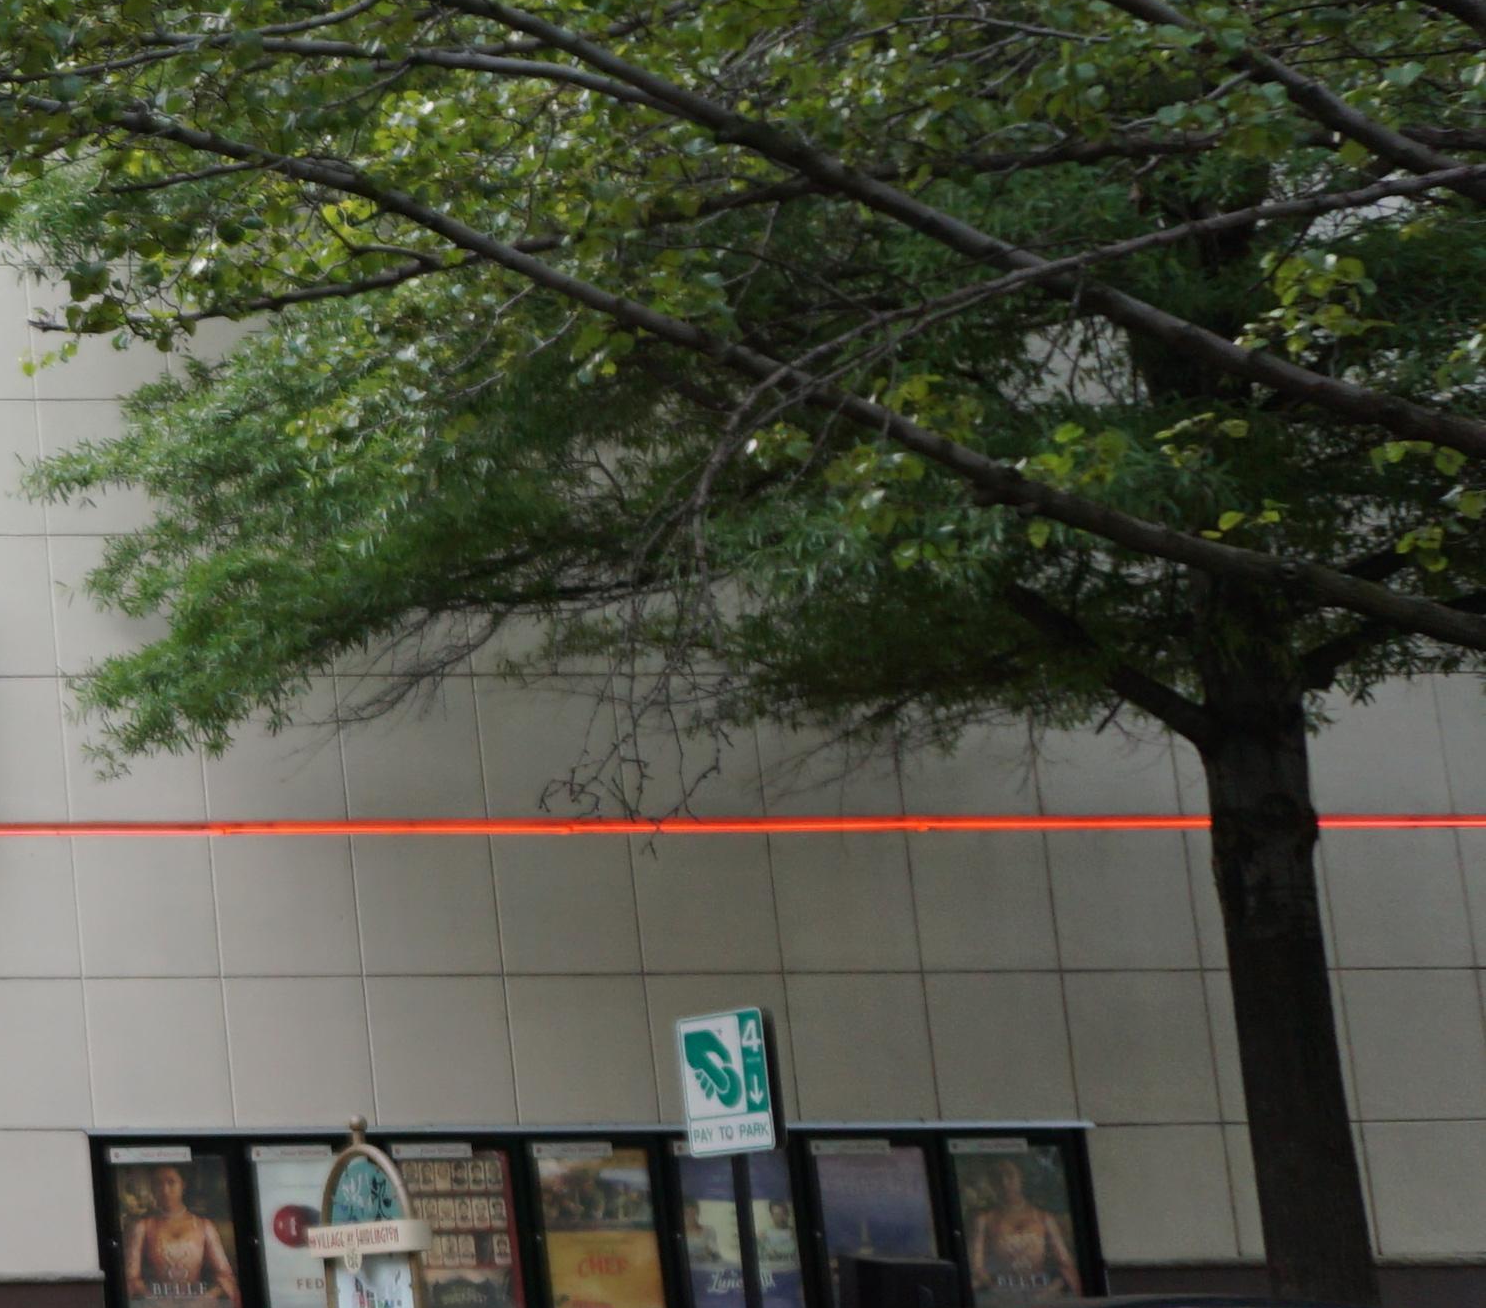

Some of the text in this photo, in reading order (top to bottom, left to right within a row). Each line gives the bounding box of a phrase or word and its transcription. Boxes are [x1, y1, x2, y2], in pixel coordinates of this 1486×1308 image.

[741, 1019, 761, 1052] 4
[693, 1121, 770, 1143] PAY TO PARK
[316, 1230, 345, 1250] VILLAGE
[577, 1254, 630, 1279] CHEF
[151, 1281, 209, 1296] BELLE
